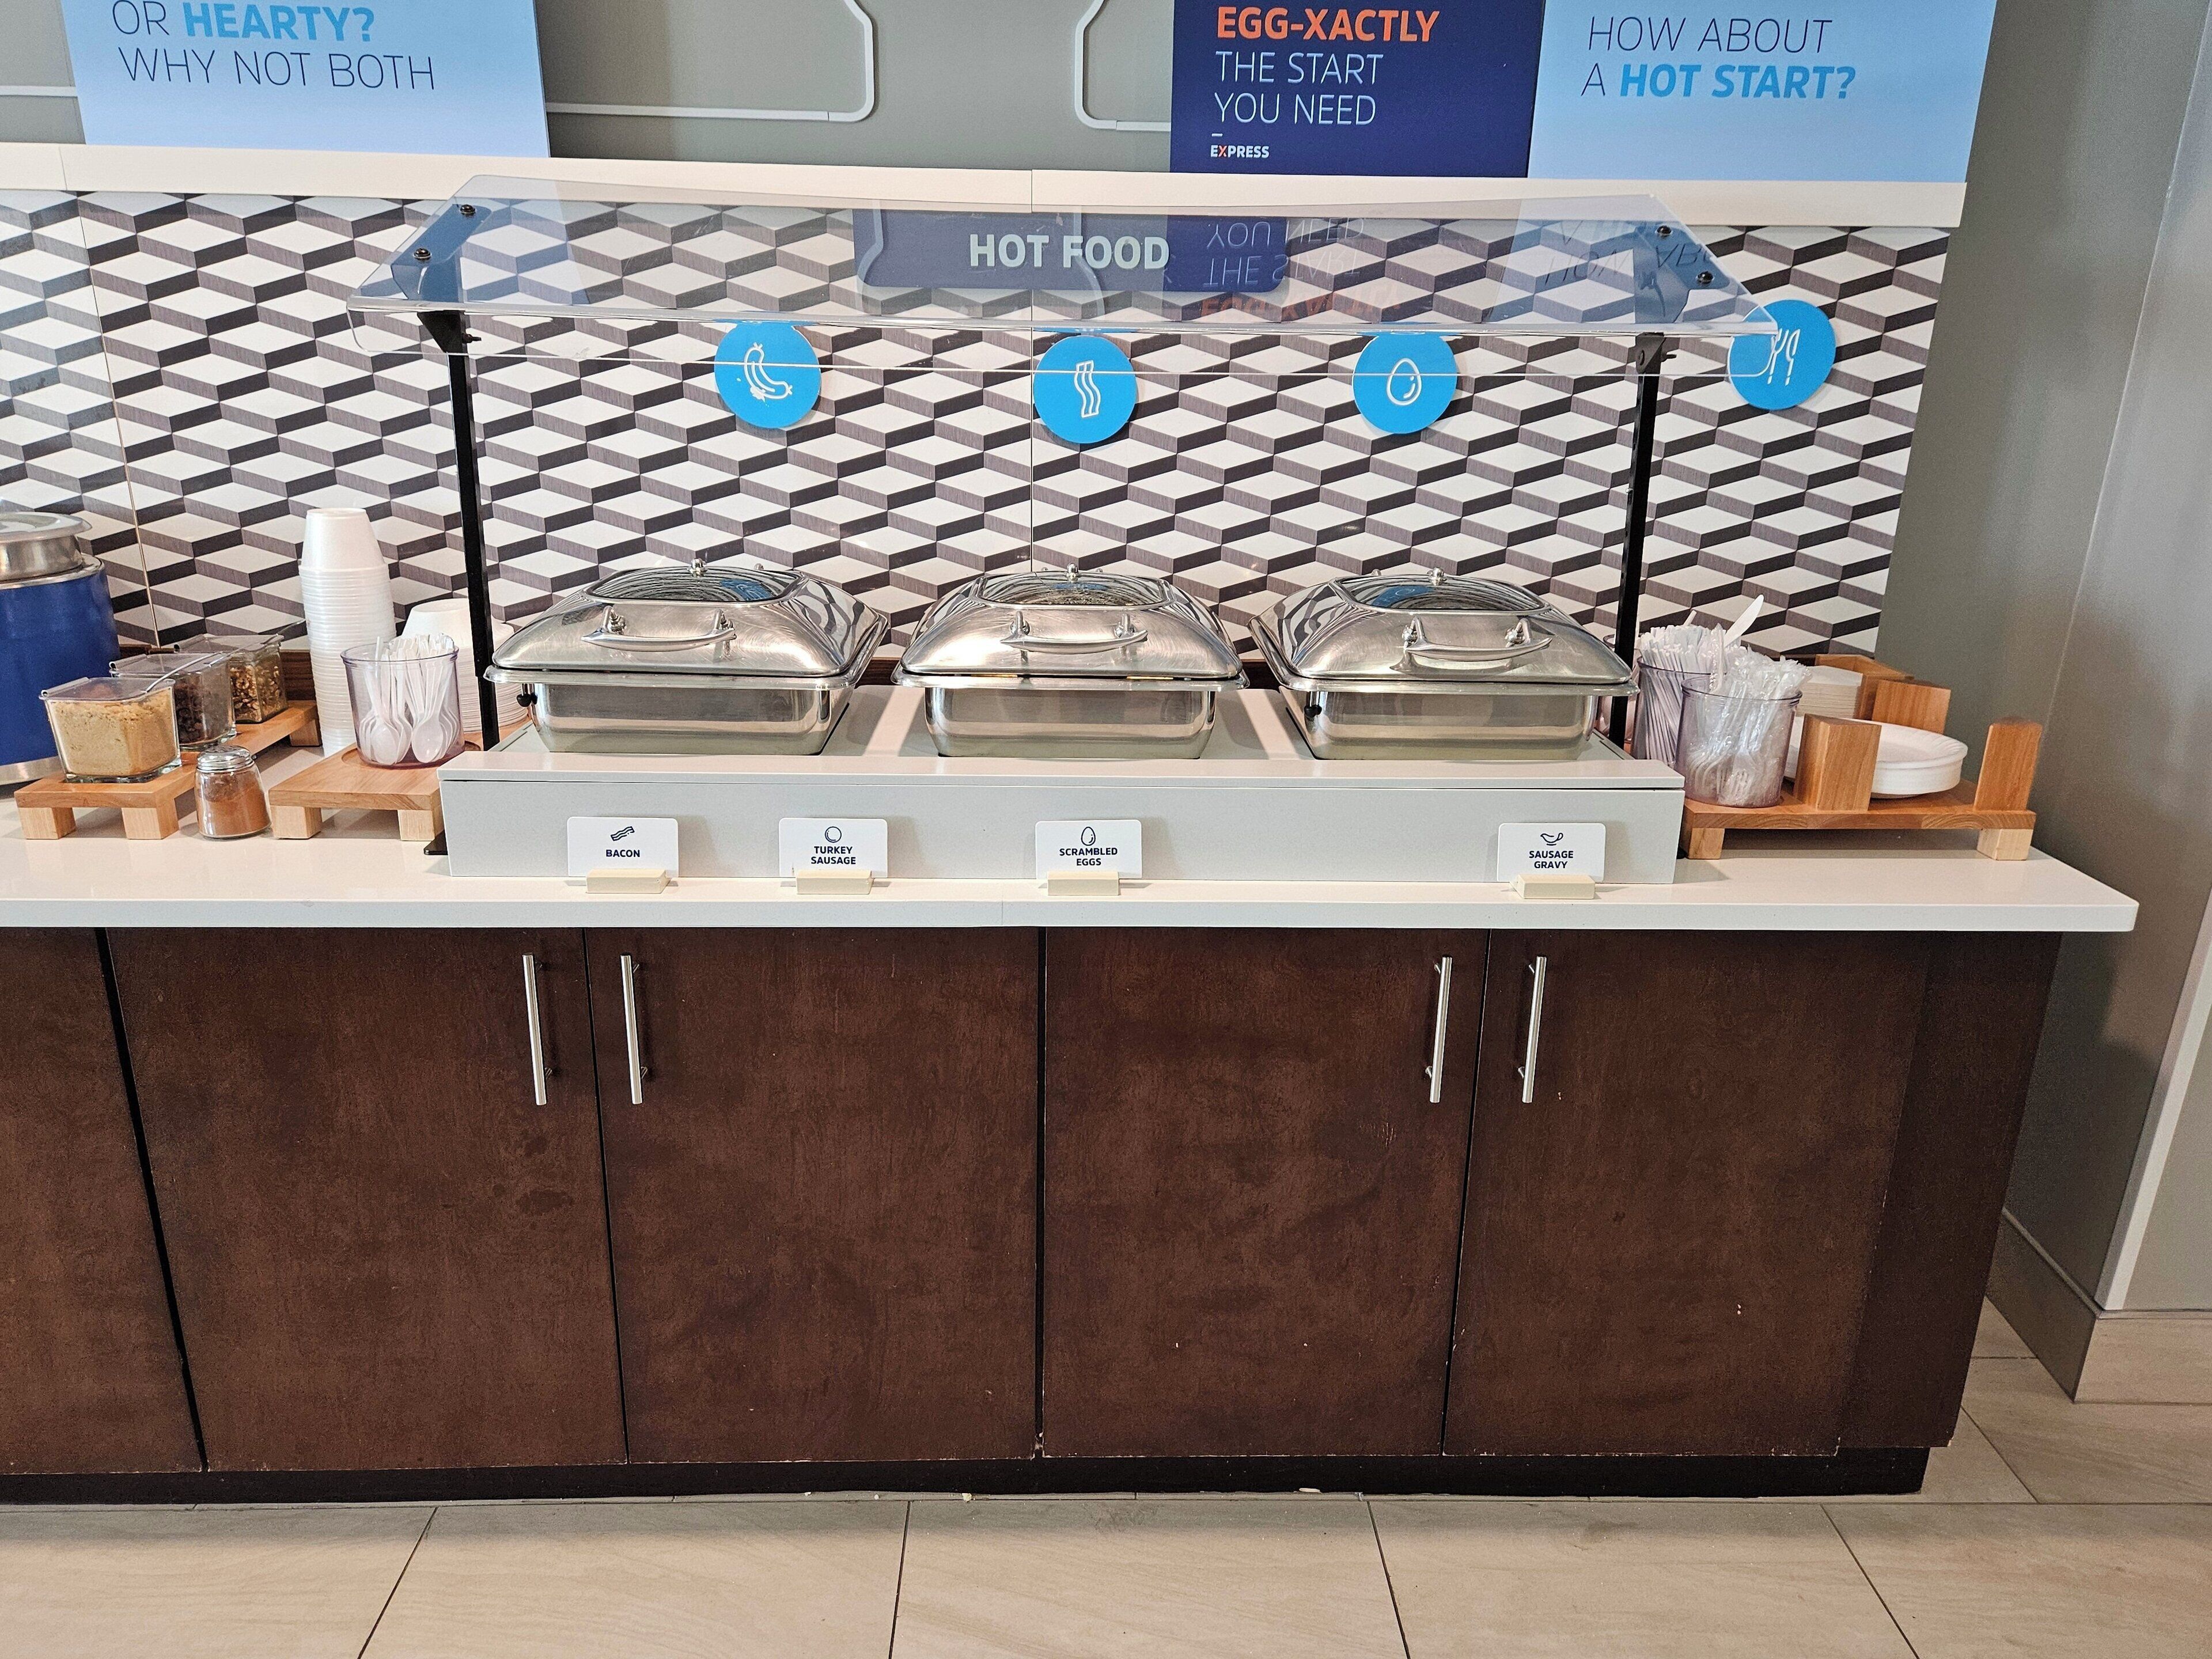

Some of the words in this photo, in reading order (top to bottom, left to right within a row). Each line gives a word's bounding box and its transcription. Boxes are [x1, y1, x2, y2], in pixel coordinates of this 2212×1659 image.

[112, 0, 170, 35] OR
[183, 2, 374, 42] HEARTY?
[1217, 6, 1440, 42] EGG-XACTLY
[1588, 16, 1686, 51] HOW
[1697, 18, 1833, 53] ABOUT
[118, 47, 215, 83] WHY
[233, 50, 311, 86] NOT
[329, 54, 435, 90] BOTH
[1215, 51, 1276, 83] THE
[1287, 52, 1384, 85] START
[1581, 63, 1606, 96] A
[1620, 63, 1702, 97] HOT
[1711, 65, 1856, 99] START?
[1214, 92, 1280, 123] YOU
[1294, 94, 1376, 125] NEED
[1210, 145, 1270, 158] EXPRESS
[970, 234, 1050, 268] HOT
[1063, 235, 1170, 270] FOOD
[605, 849, 641, 858] BACON
[810, 856, 856, 865] SAUSAGE
[813, 846, 853, 854] TURKEY
[1059, 847, 1118, 857] SCRAMBLED
[1529, 850, 1574, 858] SAUSAGE
[1076, 858, 1101, 866] EGGS
[1534, 861, 1568, 869] GRAVY
